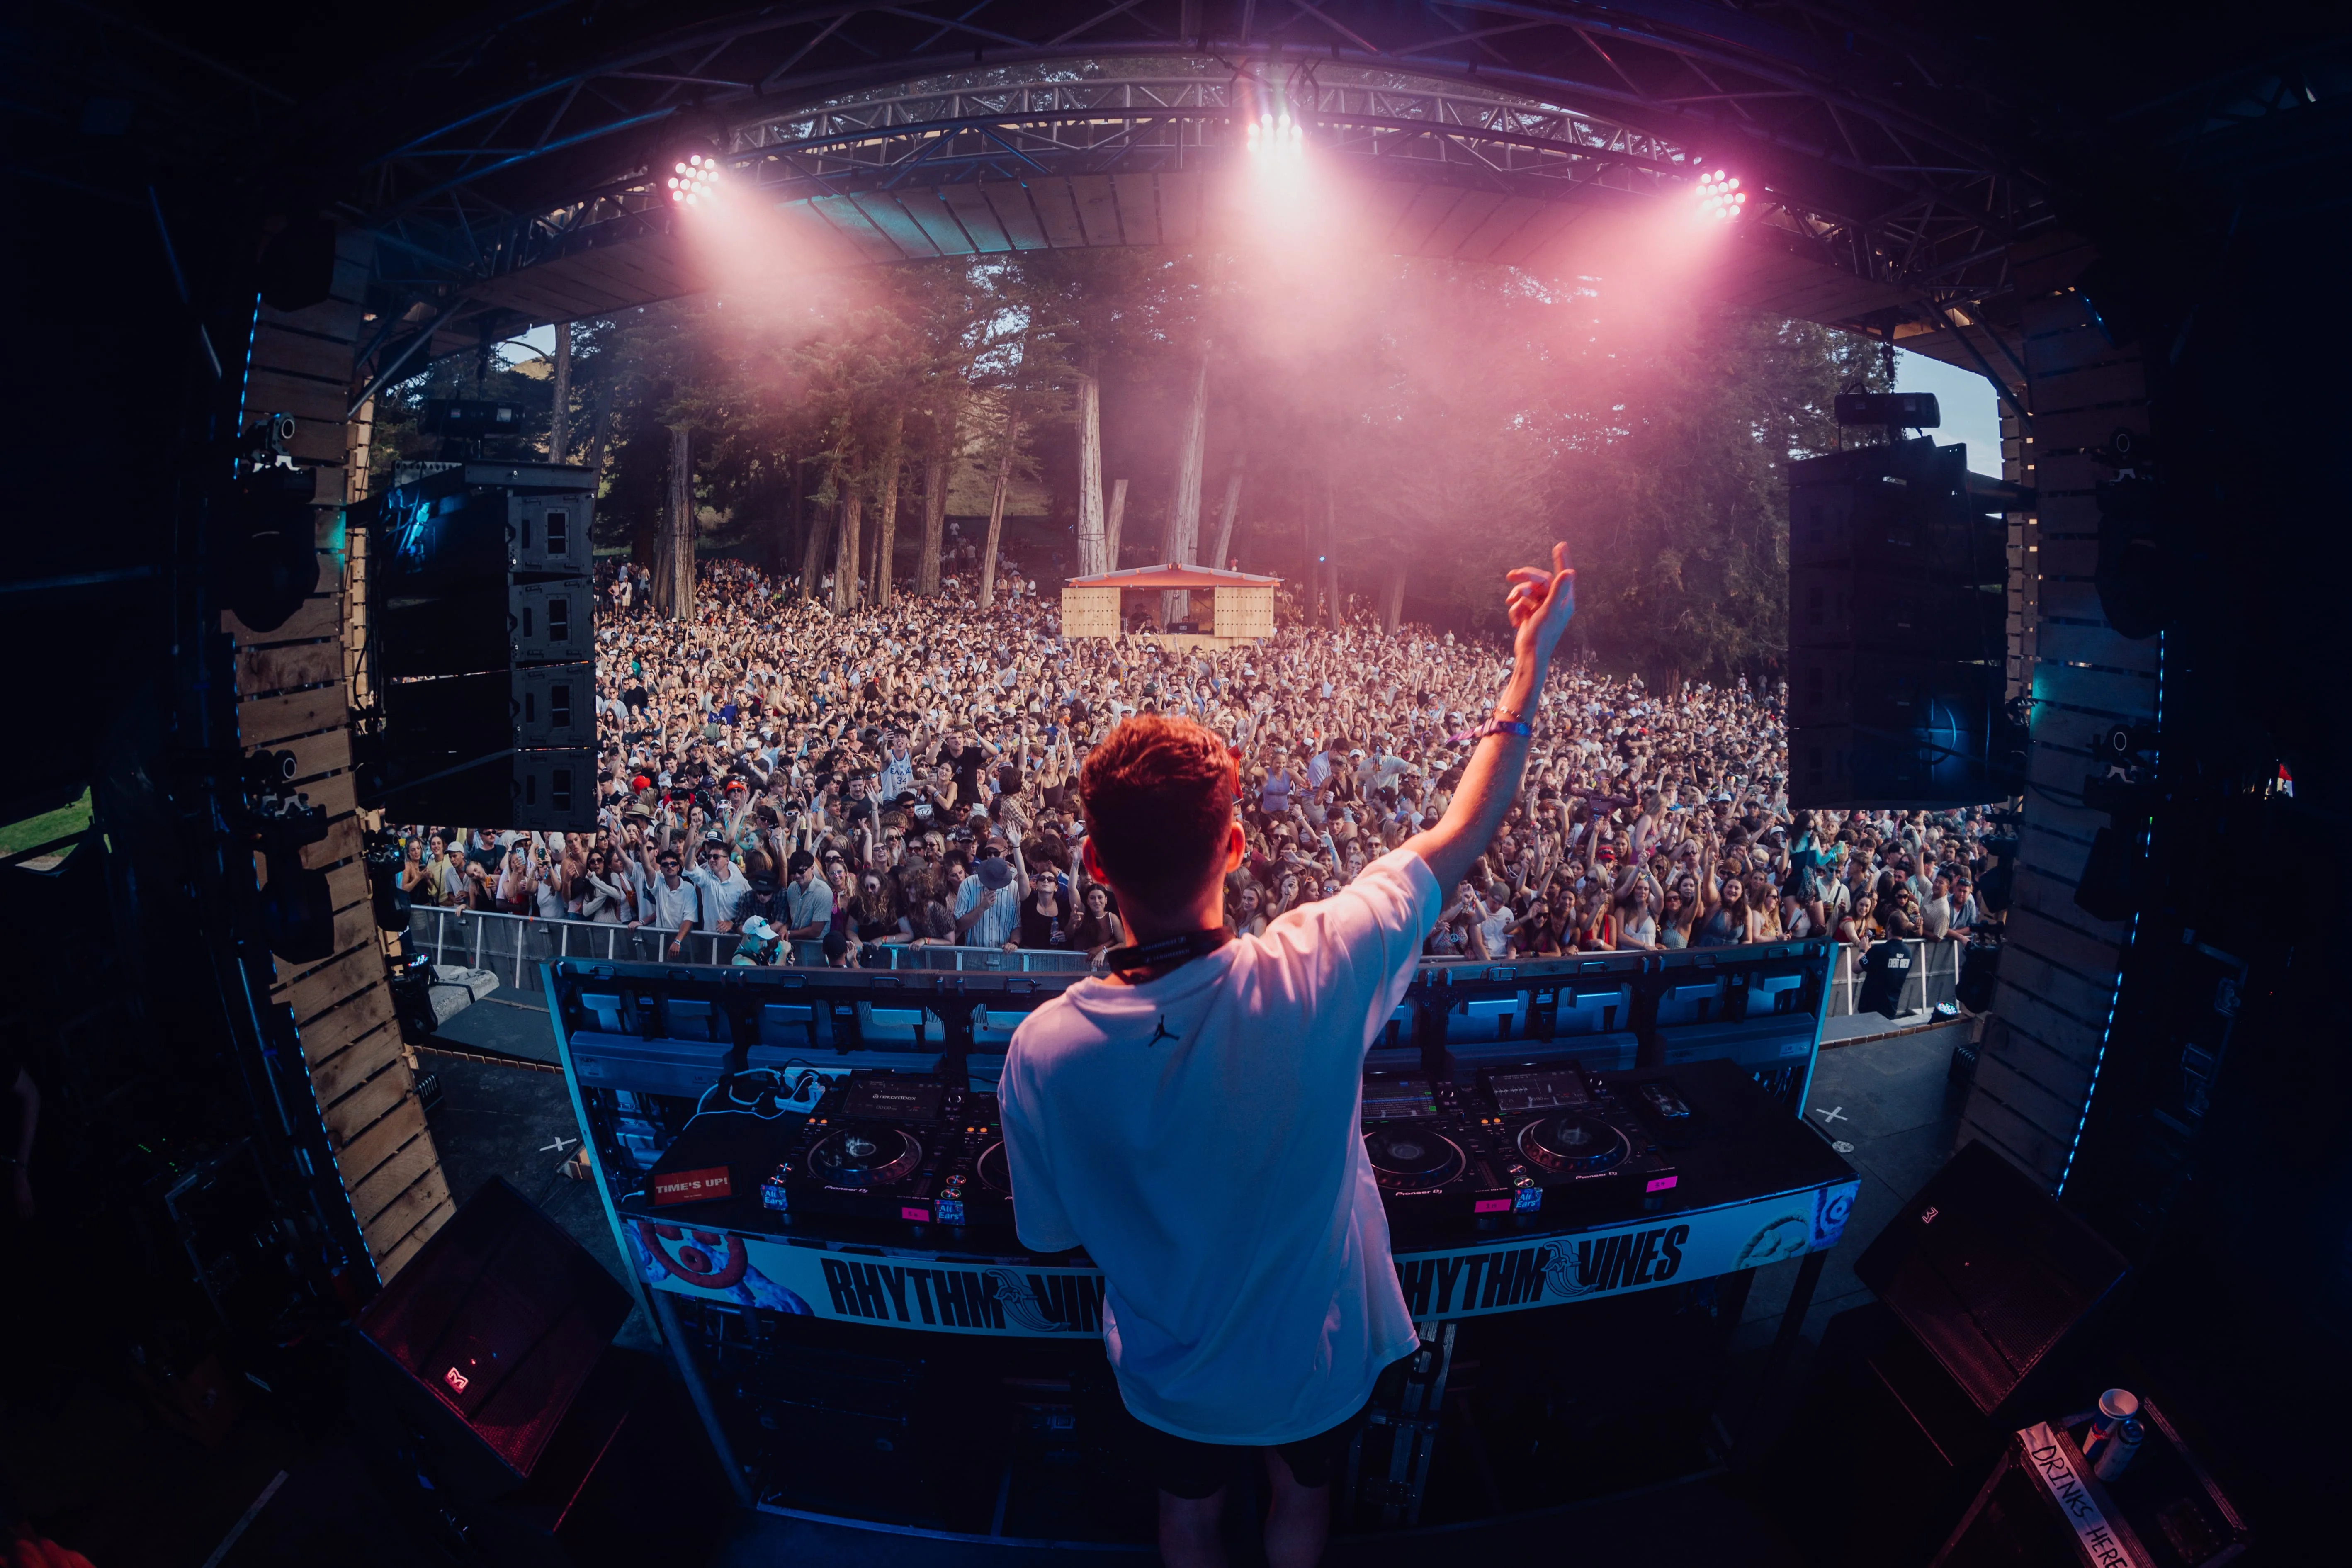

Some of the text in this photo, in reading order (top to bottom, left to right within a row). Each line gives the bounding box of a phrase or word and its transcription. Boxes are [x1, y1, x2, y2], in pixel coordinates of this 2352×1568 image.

[656, 1177, 728, 1194] TIME'S UP!
[765, 1197, 783, 1205] Ears
[938, 1212, 959, 1220] Ears
[1578, 1224, 1690, 1293] VINES
[820, 1257, 1105, 1332] RHYTHM VIN
[2032, 1445, 2128, 1568] DRINKS HERE
